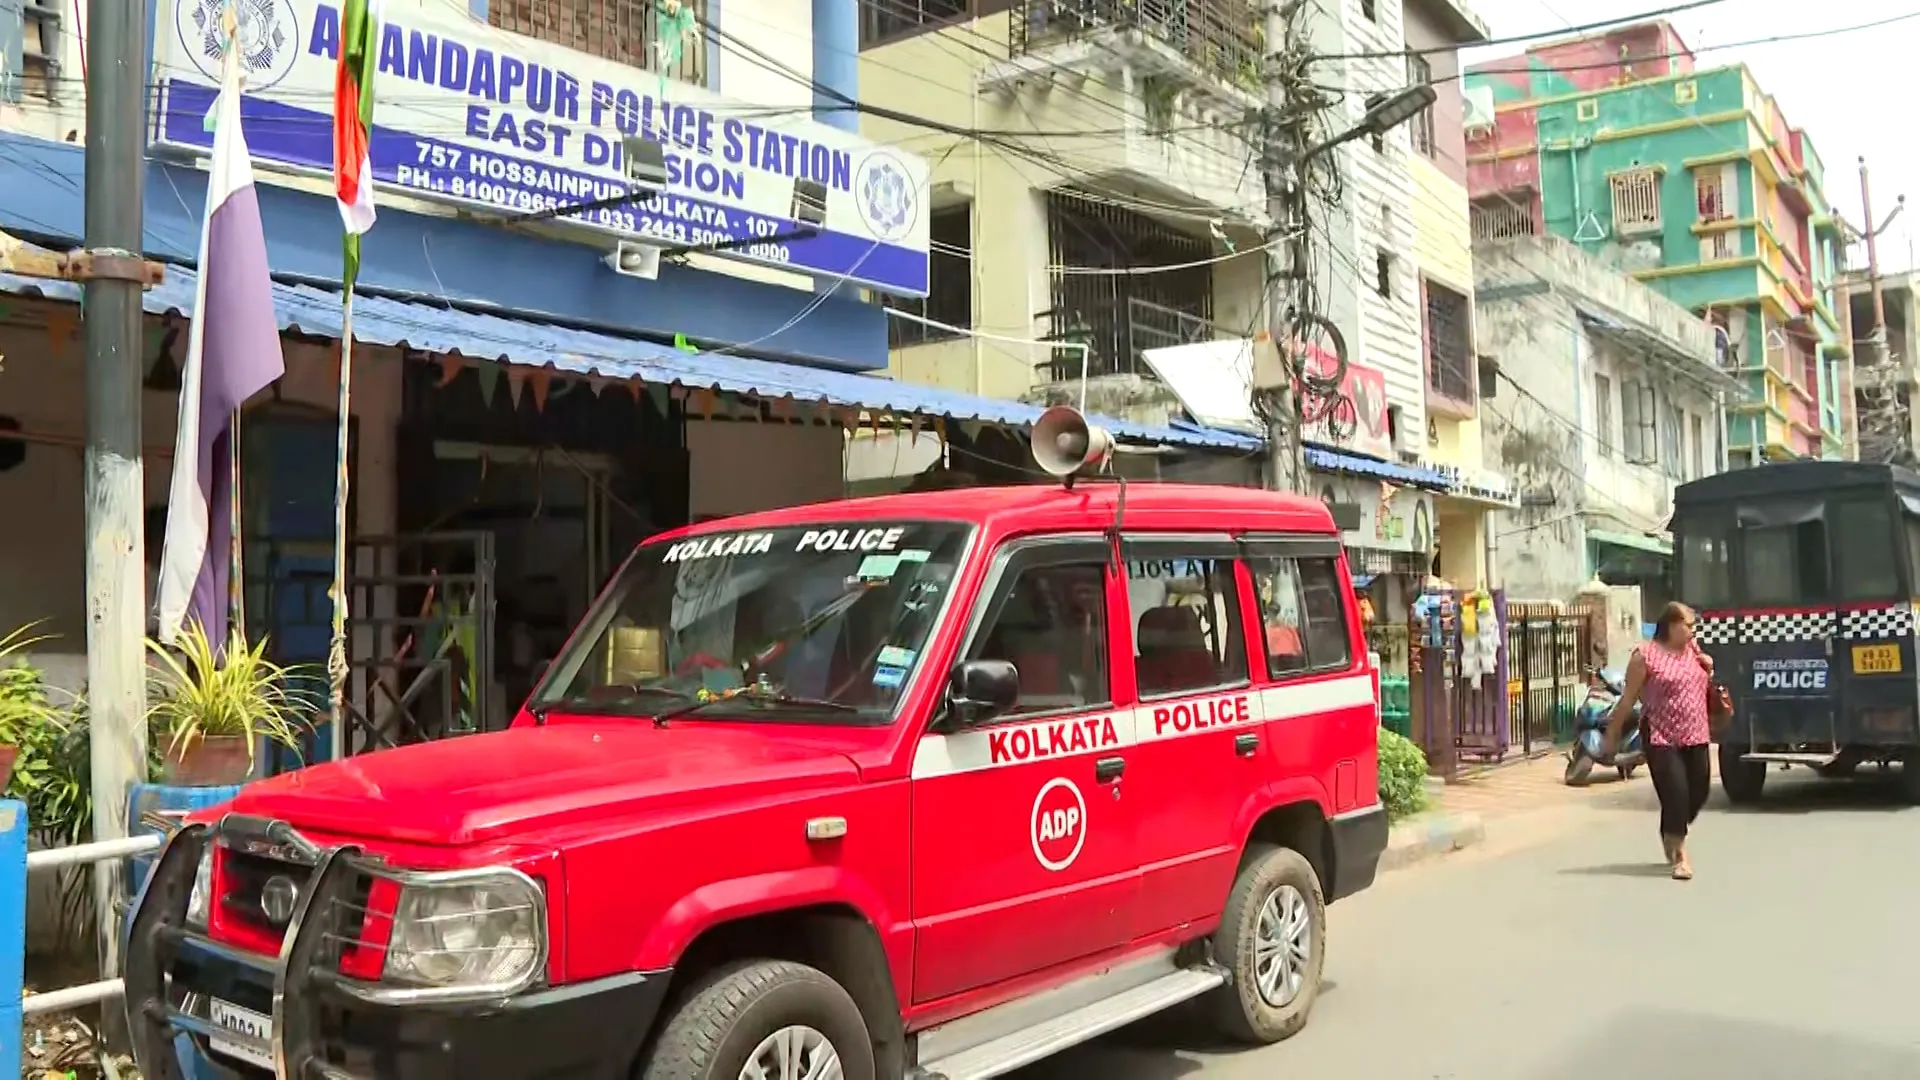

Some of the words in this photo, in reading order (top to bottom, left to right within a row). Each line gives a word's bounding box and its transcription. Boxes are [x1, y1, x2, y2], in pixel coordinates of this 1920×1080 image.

[308, 3, 579, 121] AANDAPUR
[590, 80, 714, 156] POLICE
[723, 118, 851, 192] STATION
[466, 105, 571, 157] EAST
[583, 132, 745, 200] DISION
[416, 141, 462, 170] 757
[746, 216, 779, 238] 107
[600, 207, 635, 232] 033
[641, 216, 686, 243] 2443
[663, 533, 774, 563] KOLKATA
[796, 528, 904, 551] POLICE
[1754, 671, 1827, 690] POLICE
[989, 717, 1118, 763] KOLKATA
[1154, 696, 1249, 735] POLICE
[1040, 807, 1079, 842] ADP
